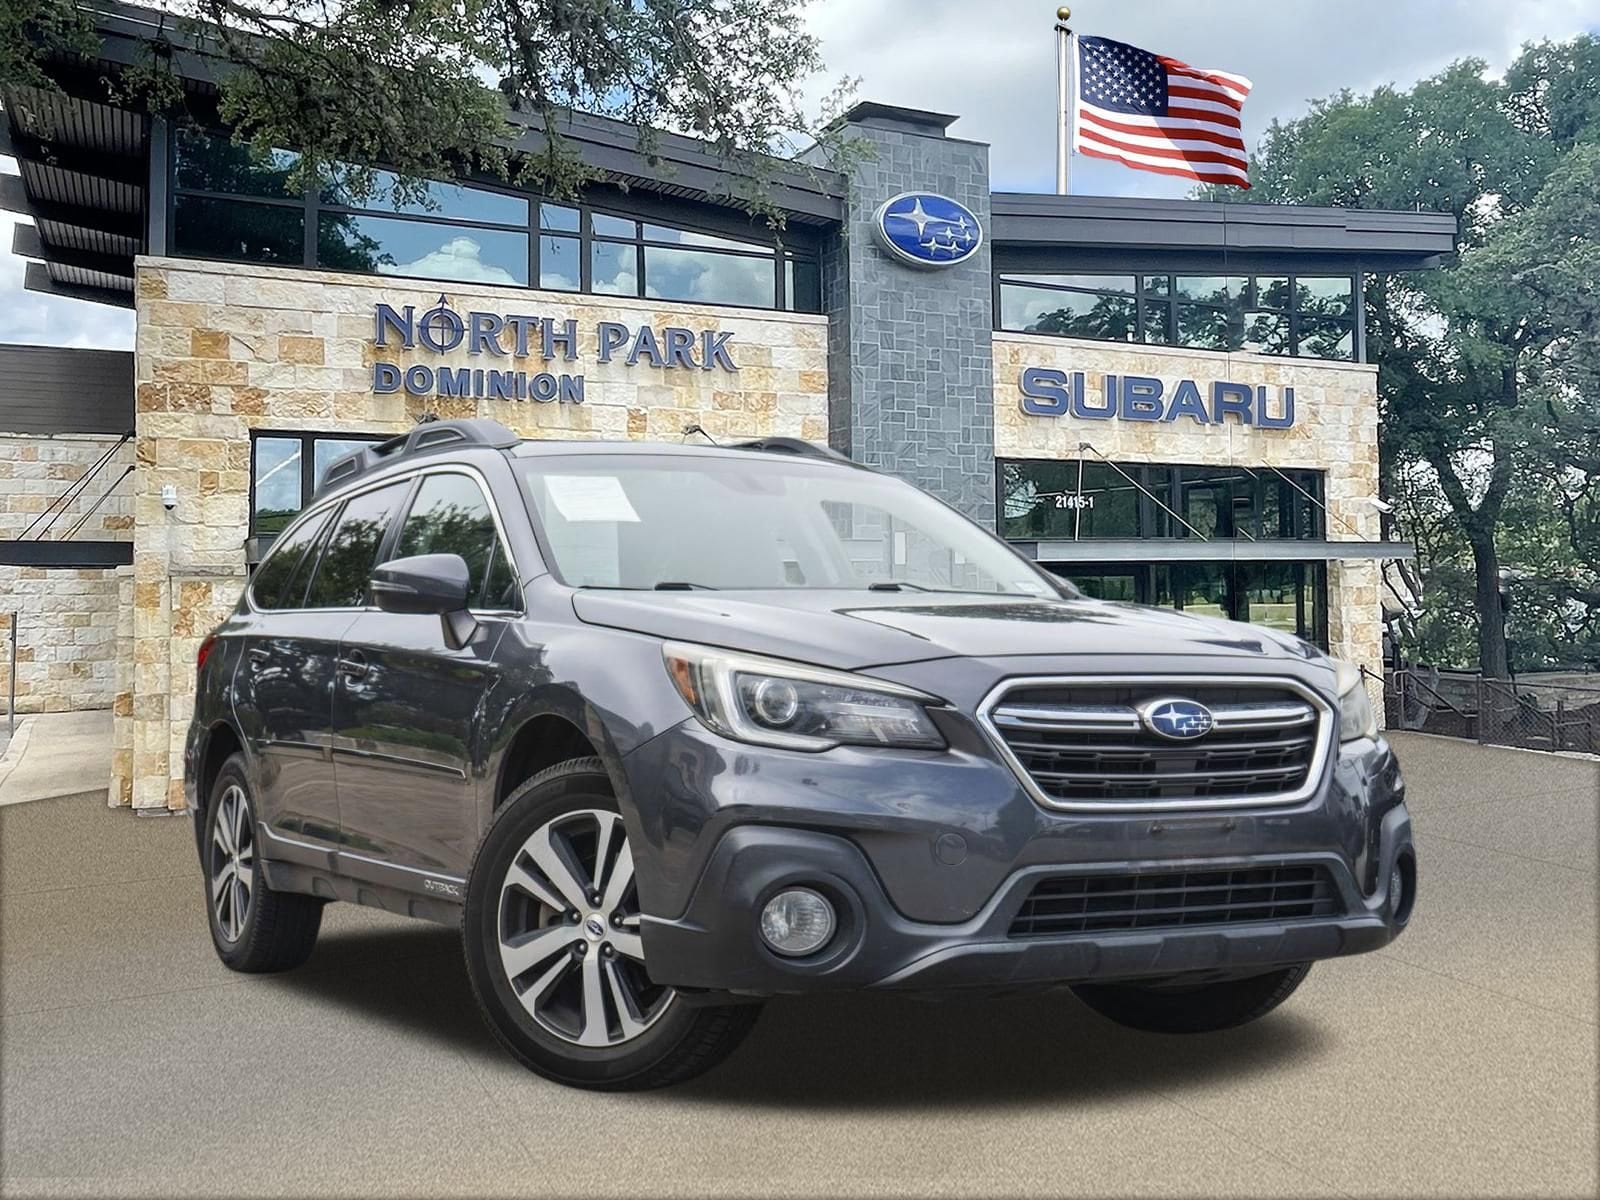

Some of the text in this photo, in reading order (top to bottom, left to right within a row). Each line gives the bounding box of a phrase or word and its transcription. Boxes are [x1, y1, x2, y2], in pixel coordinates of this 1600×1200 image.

[374, 294, 742, 372] NORTH PARK
[373, 361, 585, 403] DOMINION
[1019, 367, 1295, 429] SUBARU
